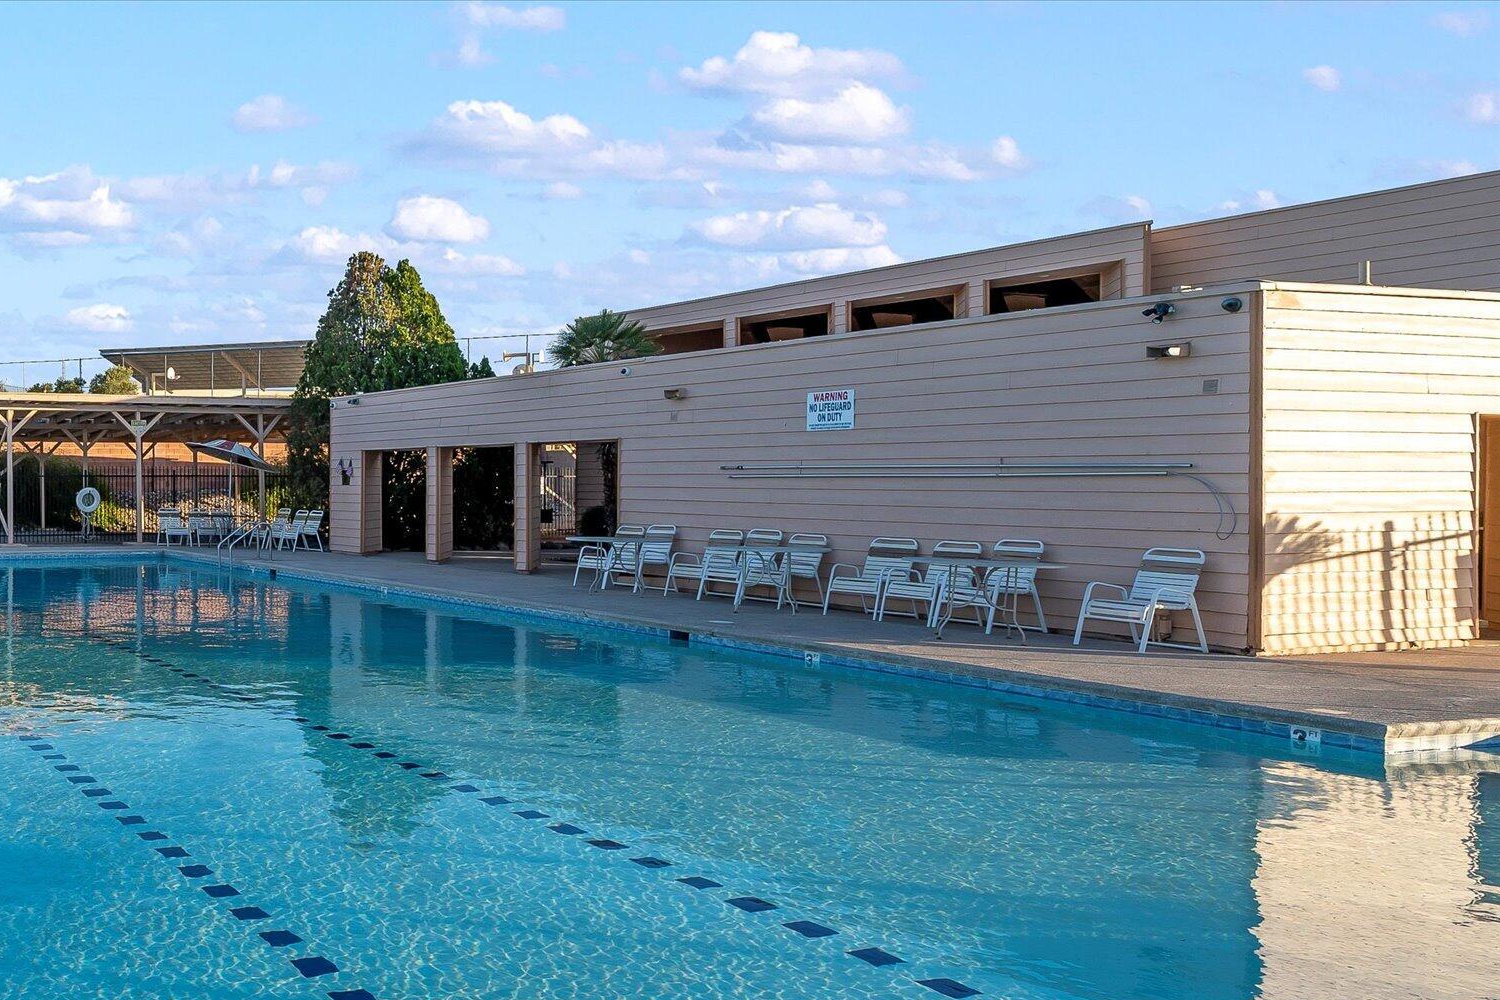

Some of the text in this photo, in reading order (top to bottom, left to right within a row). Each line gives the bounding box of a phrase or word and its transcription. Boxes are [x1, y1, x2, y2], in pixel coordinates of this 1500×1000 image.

[813, 391, 848, 402] WARNING
[809, 401, 852, 413] NO LIFEGUARD
[817, 412, 843, 422] ON DUTY
